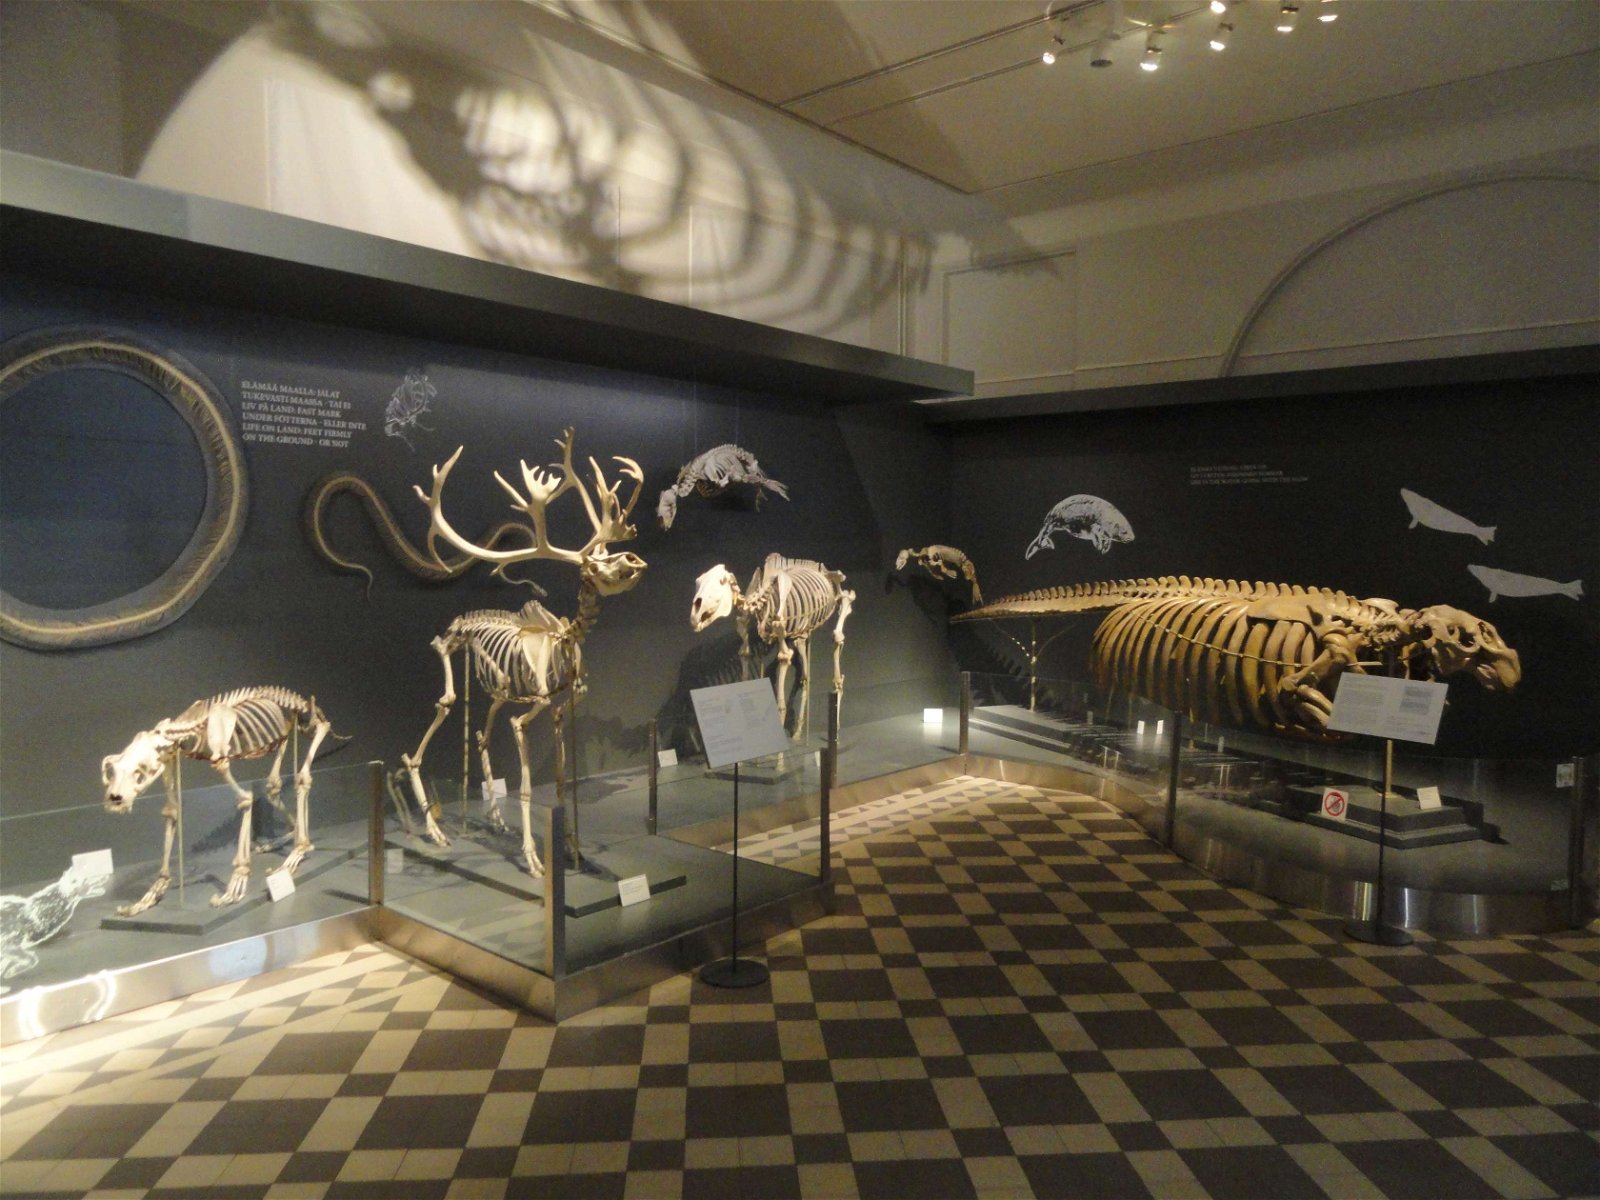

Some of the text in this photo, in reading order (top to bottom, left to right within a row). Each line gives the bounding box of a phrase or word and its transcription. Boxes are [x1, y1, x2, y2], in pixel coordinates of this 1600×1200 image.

[242, 402, 256, 410] LIV
[329, 400, 342, 408] TAI
[242, 412, 272, 422] UNDER
[324, 420, 347, 428] ELLER
[348, 422, 367, 430] INTE
[242, 422, 260, 431] LIFE
[262, 424, 275, 432] ON
[304, 427, 322, 436] FEET
[242, 433, 256, 441] ON
[258, 434, 274, 442] THE
[276, 436, 314, 446] GROUND
[332, 440, 350, 448] NOT
